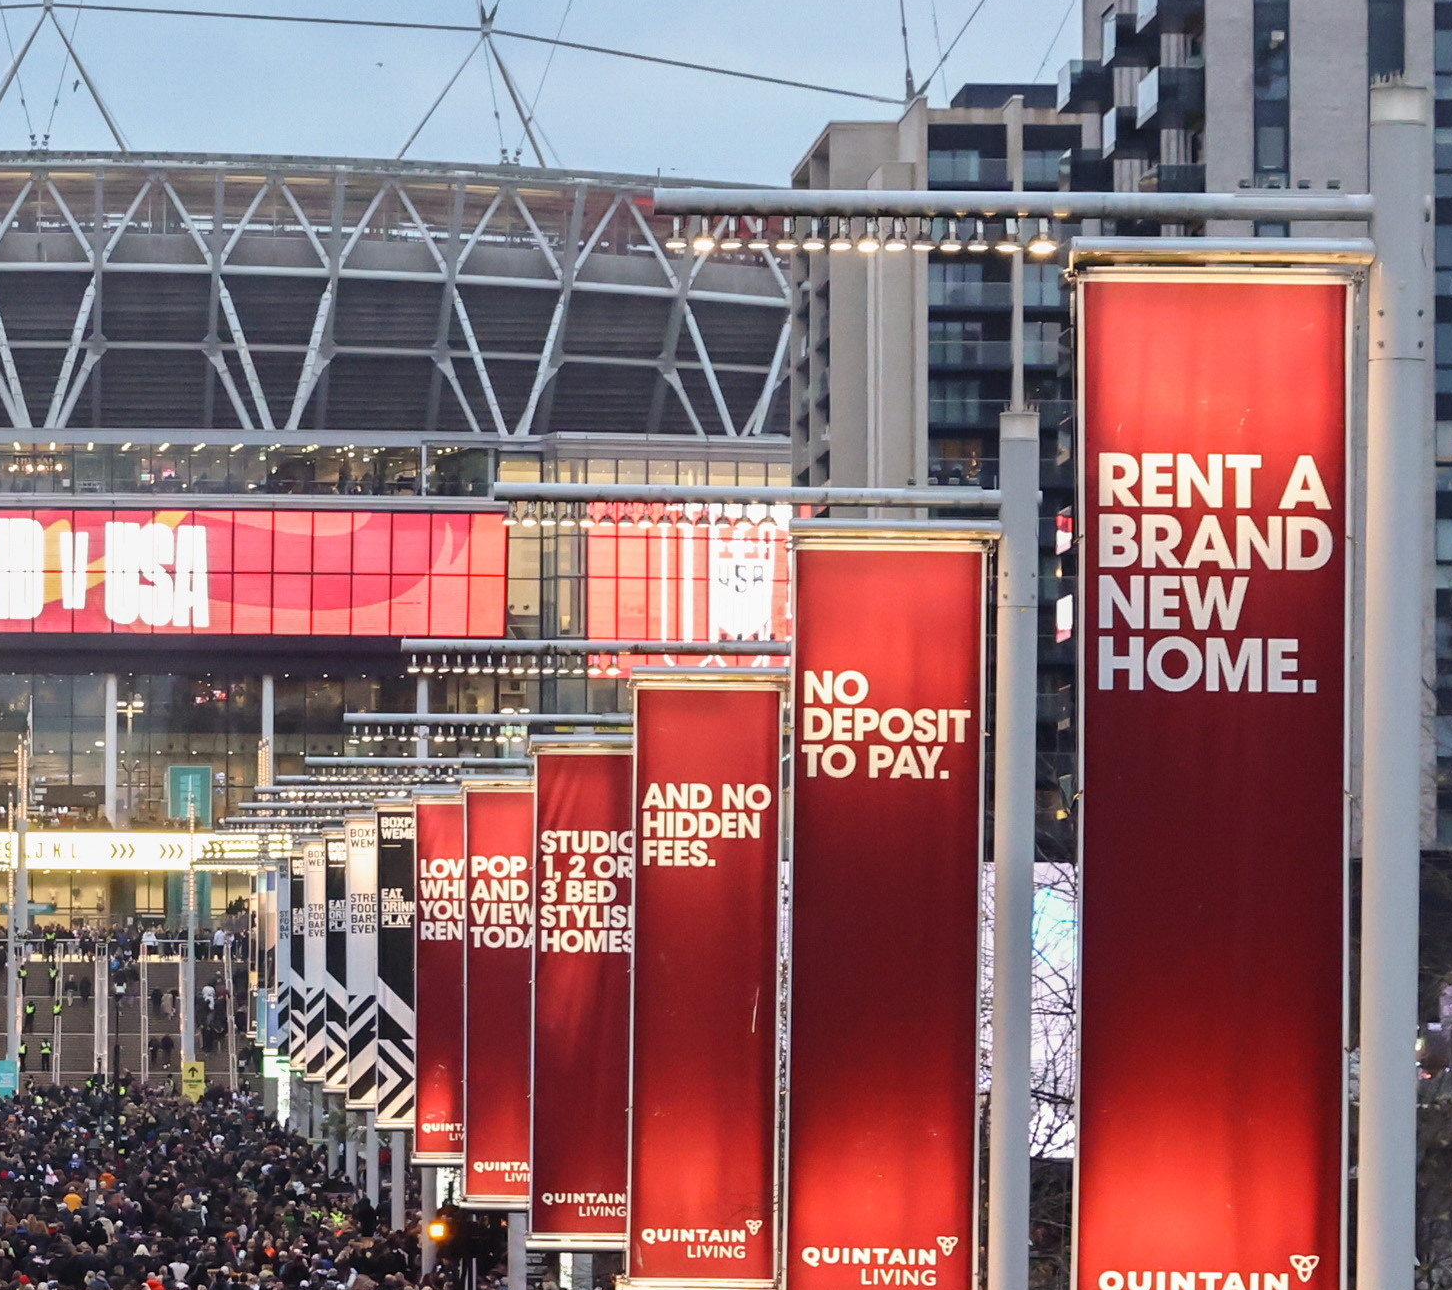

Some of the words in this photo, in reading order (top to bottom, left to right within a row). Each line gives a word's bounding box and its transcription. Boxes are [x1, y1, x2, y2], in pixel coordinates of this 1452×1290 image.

[1099, 453, 1262, 509] RENT
[1279, 453, 1332, 510] A
[1099, 514, 1333, 571] BRAND
[104, 520, 210, 628] USA
[1099, 575, 1250, 631] NEW
[1099, 636, 1317, 693] HOME.
[804, 670, 869, 705] NO
[803, 708, 972, 744] DEPOSIT
[802, 744, 856, 778] TO
[869, 745, 950, 780] PAY.
[642, 783, 713, 811] AND
[721, 783, 772, 811] NO
[642, 811, 761, 839] HIDDEN
[642, 839, 717, 868] FEES.
[471, 856, 527, 878] POP
[542, 854, 562, 882] 1,
[569, 854, 587, 878] 2
[594, 854, 633, 879] OR
[381, 888, 404, 900] EAT.
[471, 878, 528, 902] AND
[541, 880, 558, 903] 3
[566, 880, 617, 903] BED
[382, 914, 412, 926] PLAY.
[421, 900, 467, 921] YOU
[421, 1122, 466, 1134] QUINT
[542, 1192, 627, 1207] QUINTAIN
[579, 1206, 627, 1219] LIVING
[641, 1228, 747, 1245] QUINTAIN
[687, 1245, 747, 1260] LIVING
[802, 1246, 937, 1267] QUINTAIN
[860, 1268, 937, 1287] LIVING
